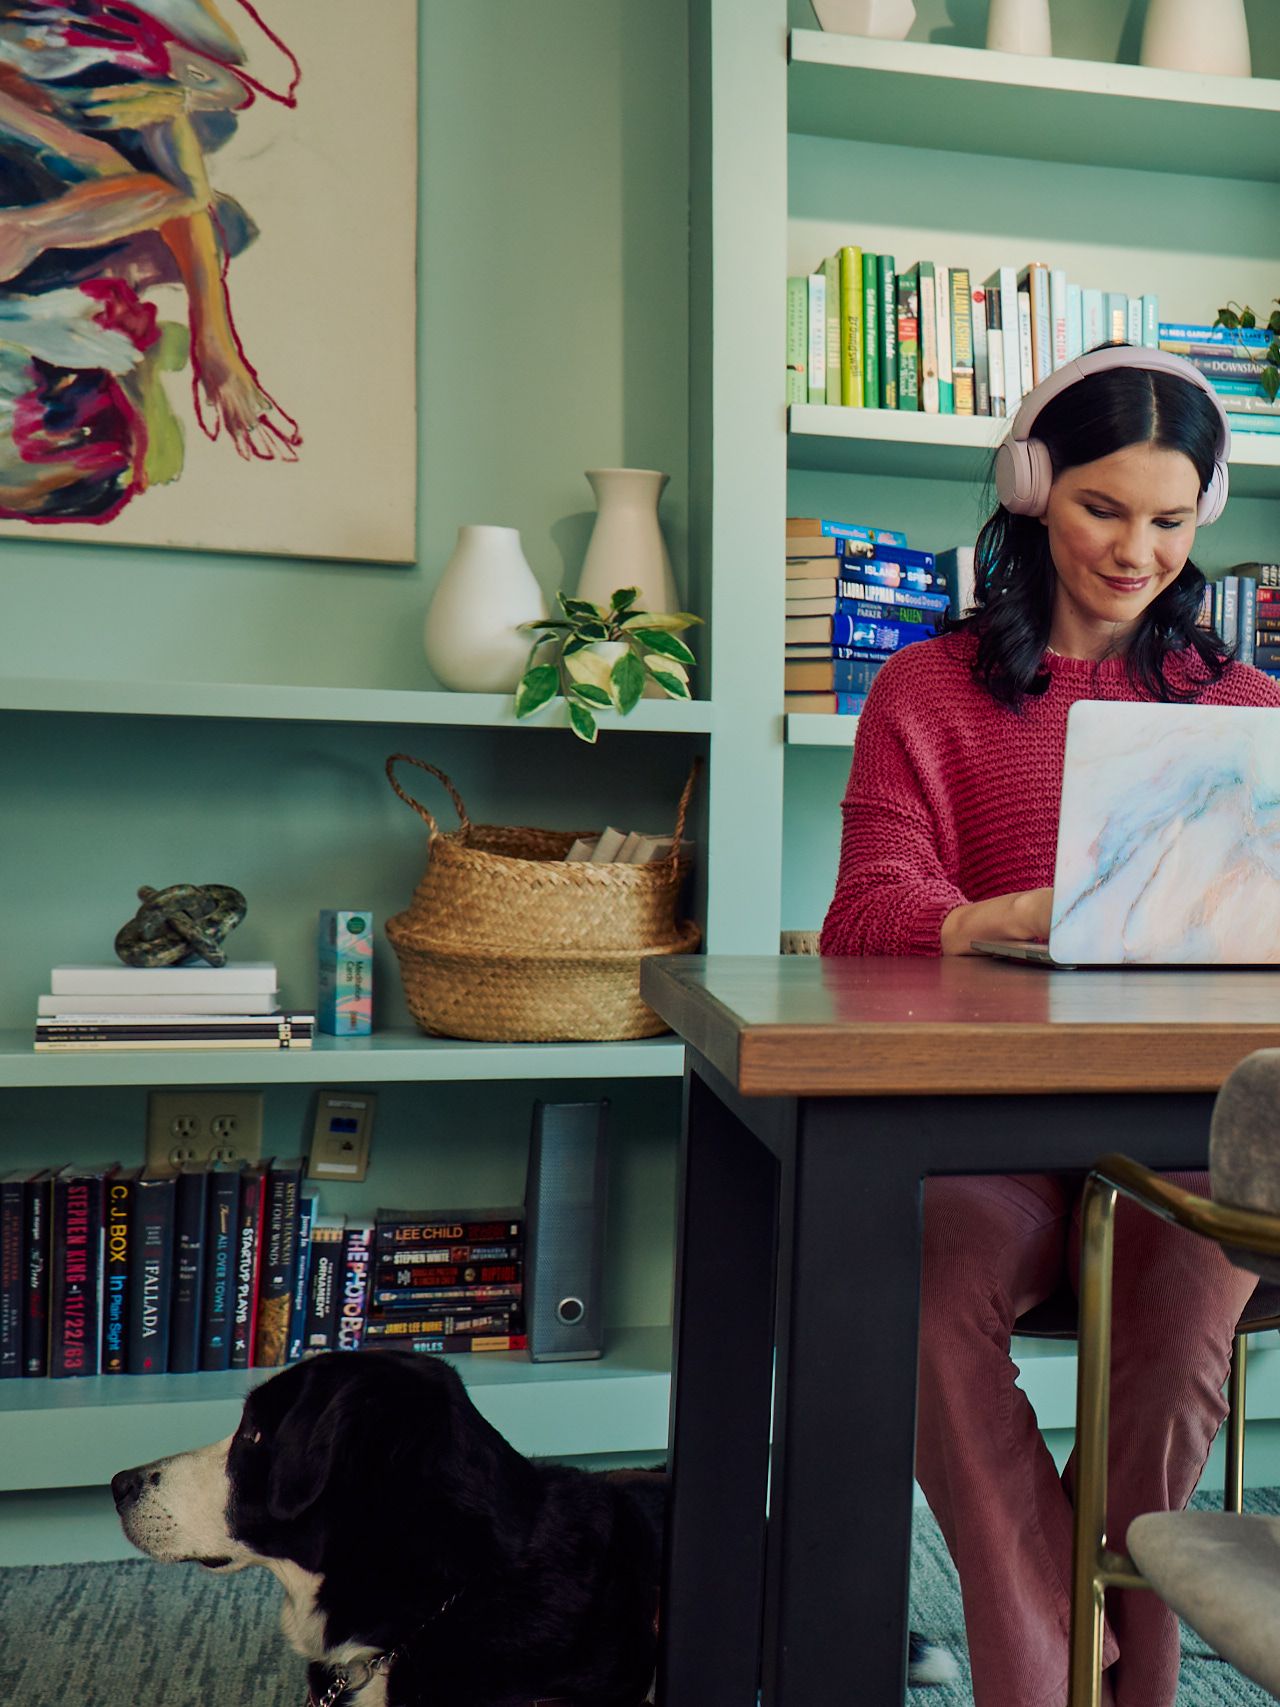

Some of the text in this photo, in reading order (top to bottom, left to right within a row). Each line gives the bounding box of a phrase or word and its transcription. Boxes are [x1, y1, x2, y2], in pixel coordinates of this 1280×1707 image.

[953, 272, 971, 359] WILLIAM LASHNER
[848, 316, 860, 377] groundswell
[1056, 318, 1066, 361] TRACTION
[857, 608, 882, 619] PARKER
[354, 961, 363, 1001] Meditation
[217, 1234, 228, 1250] ALL
[269, 1182, 283, 1266] THE FOUR WINDS
[281, 1182, 295, 1265] KRISTIN HANNAH
[300, 1215, 310, 1237] Jump
[395, 1228, 420, 1240] LEE
[423, 1226, 463, 1238] CHILD
[216, 1253, 226, 1278] OVER
[238, 1228, 253, 1282] STARTUP
[347, 1231, 370, 1261] THE
[394, 1253, 449, 1264] STEPHEN WHITE
[64, 1186, 88, 1369] STEPHEN KING 11/22/63
[107, 1186, 127, 1350] C. J. BOX In Plain Sight
[315, 1257, 327, 1318] ORNAMENT
[343, 1263, 368, 1316] PHOTO
[142, 1266, 159, 1338] FALLADA
[213, 1281, 225, 1313] TOWN
[384, 1320, 443, 1334] JAMES LEE BURKE
